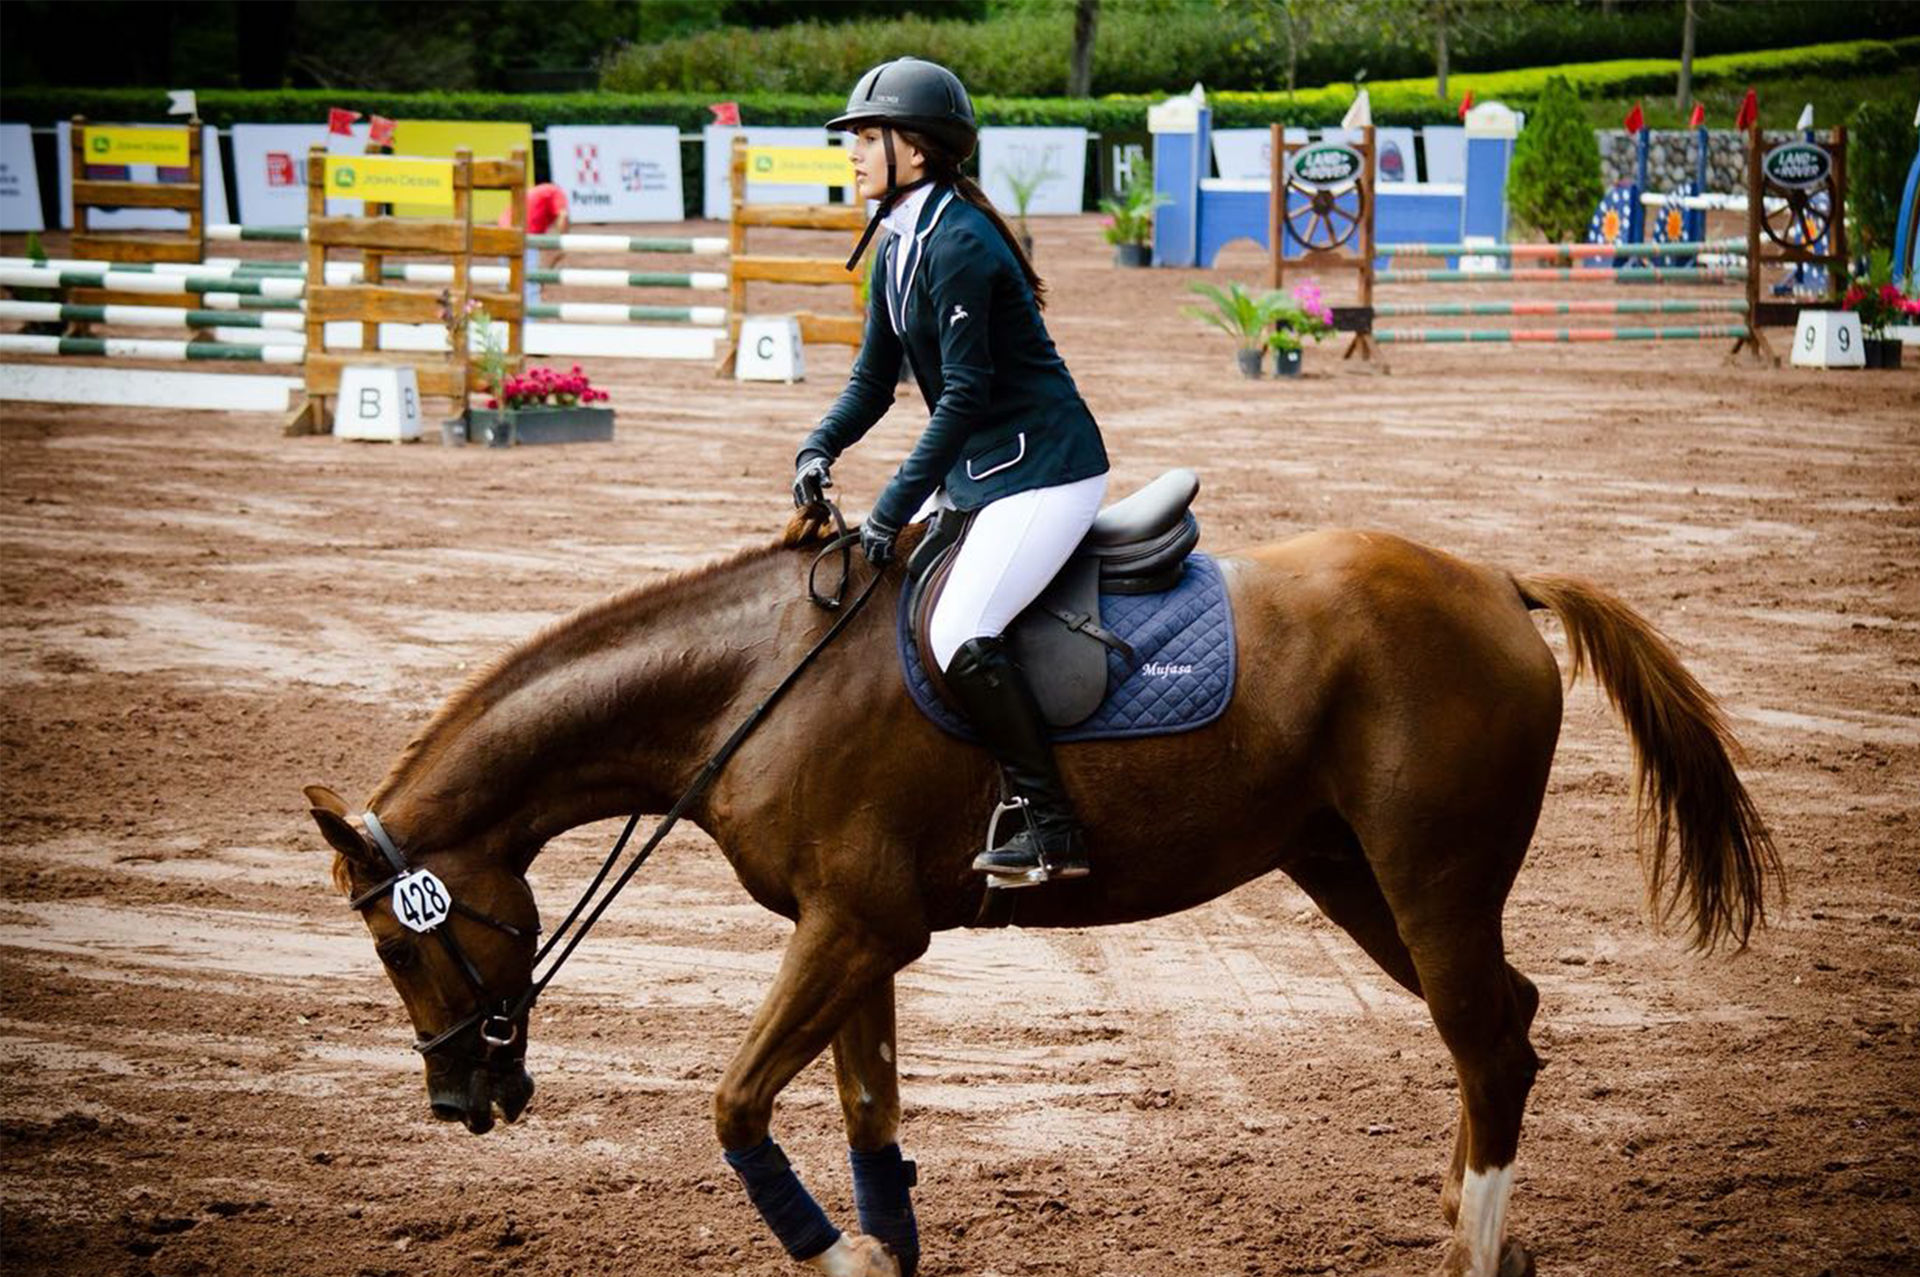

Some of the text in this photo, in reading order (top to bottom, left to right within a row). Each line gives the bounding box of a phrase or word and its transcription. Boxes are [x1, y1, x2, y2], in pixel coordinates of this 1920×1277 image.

[1304, 151, 1341, 168] LAND
[1777, 151, 1811, 166] LAND
[1308, 163, 1352, 180] ROVER
[1779, 164, 1820, 179] ROVER
[757, 335, 774, 360] C
[1804, 325, 1816, 352] 9
[1838, 326, 1850, 352] 9
[359, 387, 381, 419] B
[404, 387, 415, 419] B
[1142, 661, 1192, 680] Mufasa
[400, 875, 447, 926] 428
